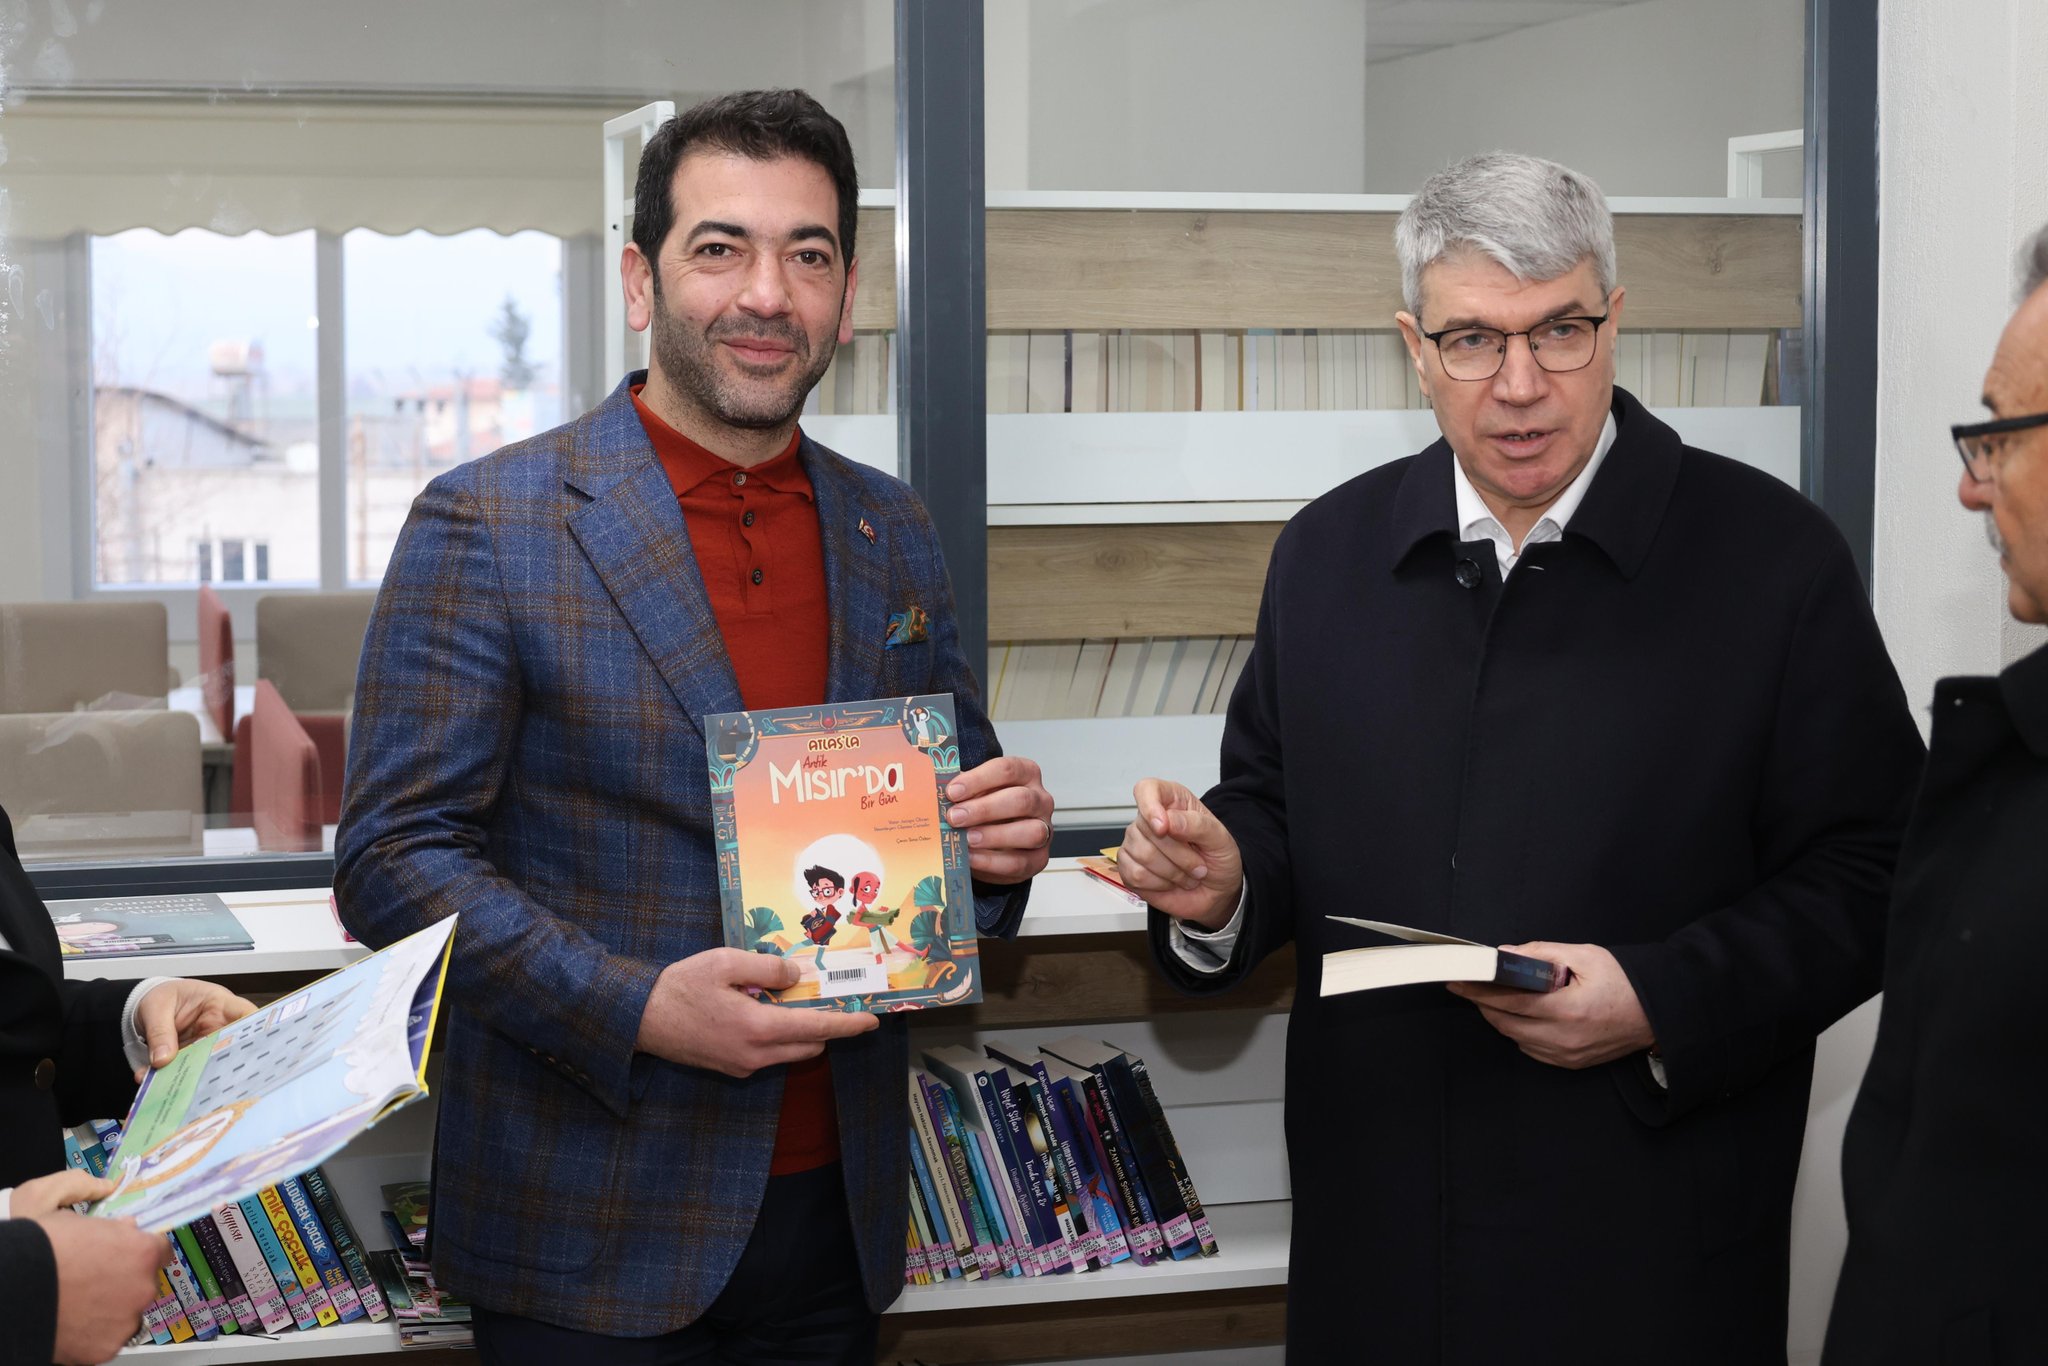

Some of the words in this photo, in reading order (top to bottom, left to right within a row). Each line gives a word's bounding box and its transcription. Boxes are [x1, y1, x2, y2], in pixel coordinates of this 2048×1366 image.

[861, 796, 875, 810] Bir
[1037, 1071, 1051, 1094] Rahime
[242, 1200, 260, 1225] Carlie
[261, 1186, 286, 1218] mik
[197, 1218, 210, 1235] AURA
[281, 1176, 312, 1220] ÜLDÜREN
[302, 1220, 326, 1253] ÇOCUK
[273, 1217, 311, 1273] çocuk
[249, 1266, 266, 1292] ŞAFA
[323, 1269, 338, 1288] Rutt
[331, 1266, 346, 1285] Hele
